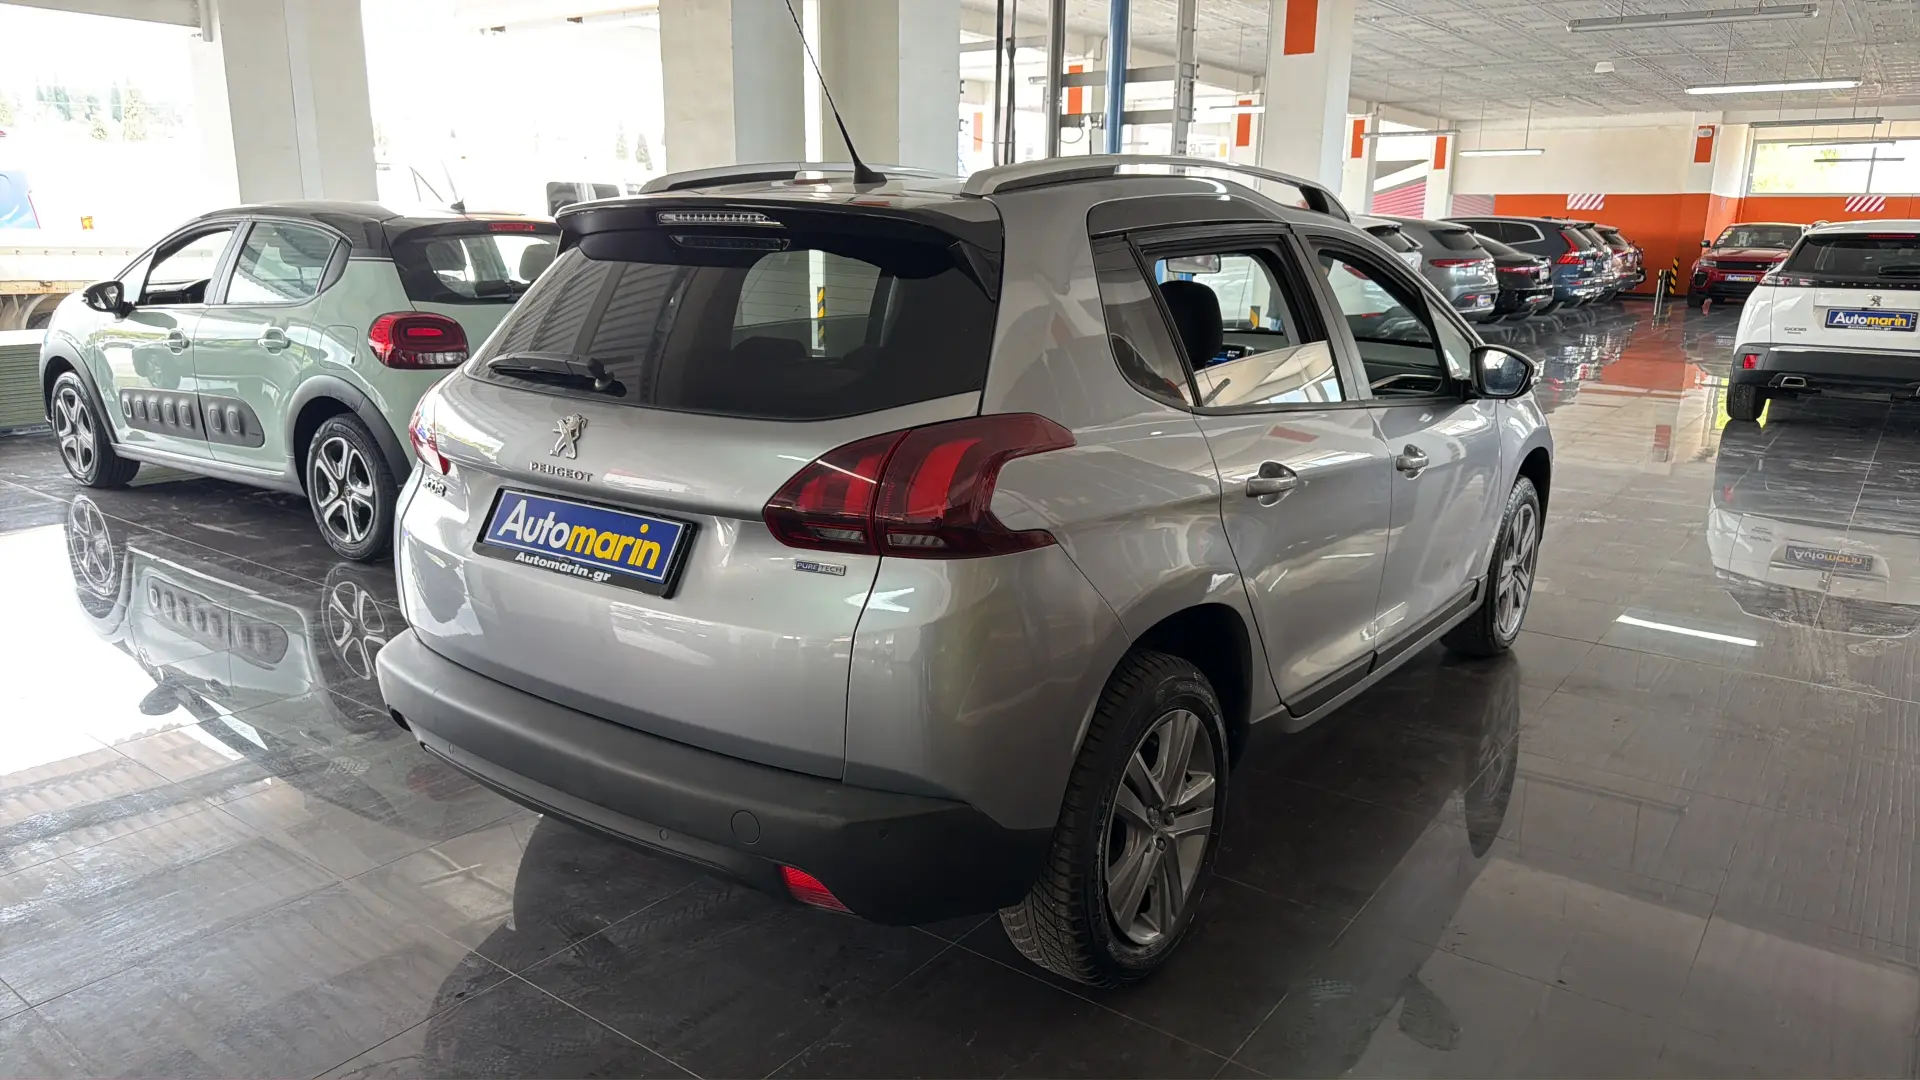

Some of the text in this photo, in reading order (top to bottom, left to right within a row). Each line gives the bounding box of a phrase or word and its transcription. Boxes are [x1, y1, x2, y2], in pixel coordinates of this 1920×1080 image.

[1833, 311, 1907, 327] Automarin
[529, 461, 594, 482] PEUGEOT
[497, 499, 661, 570] Automarin
[515, 552, 611, 582] Automarin.gr
